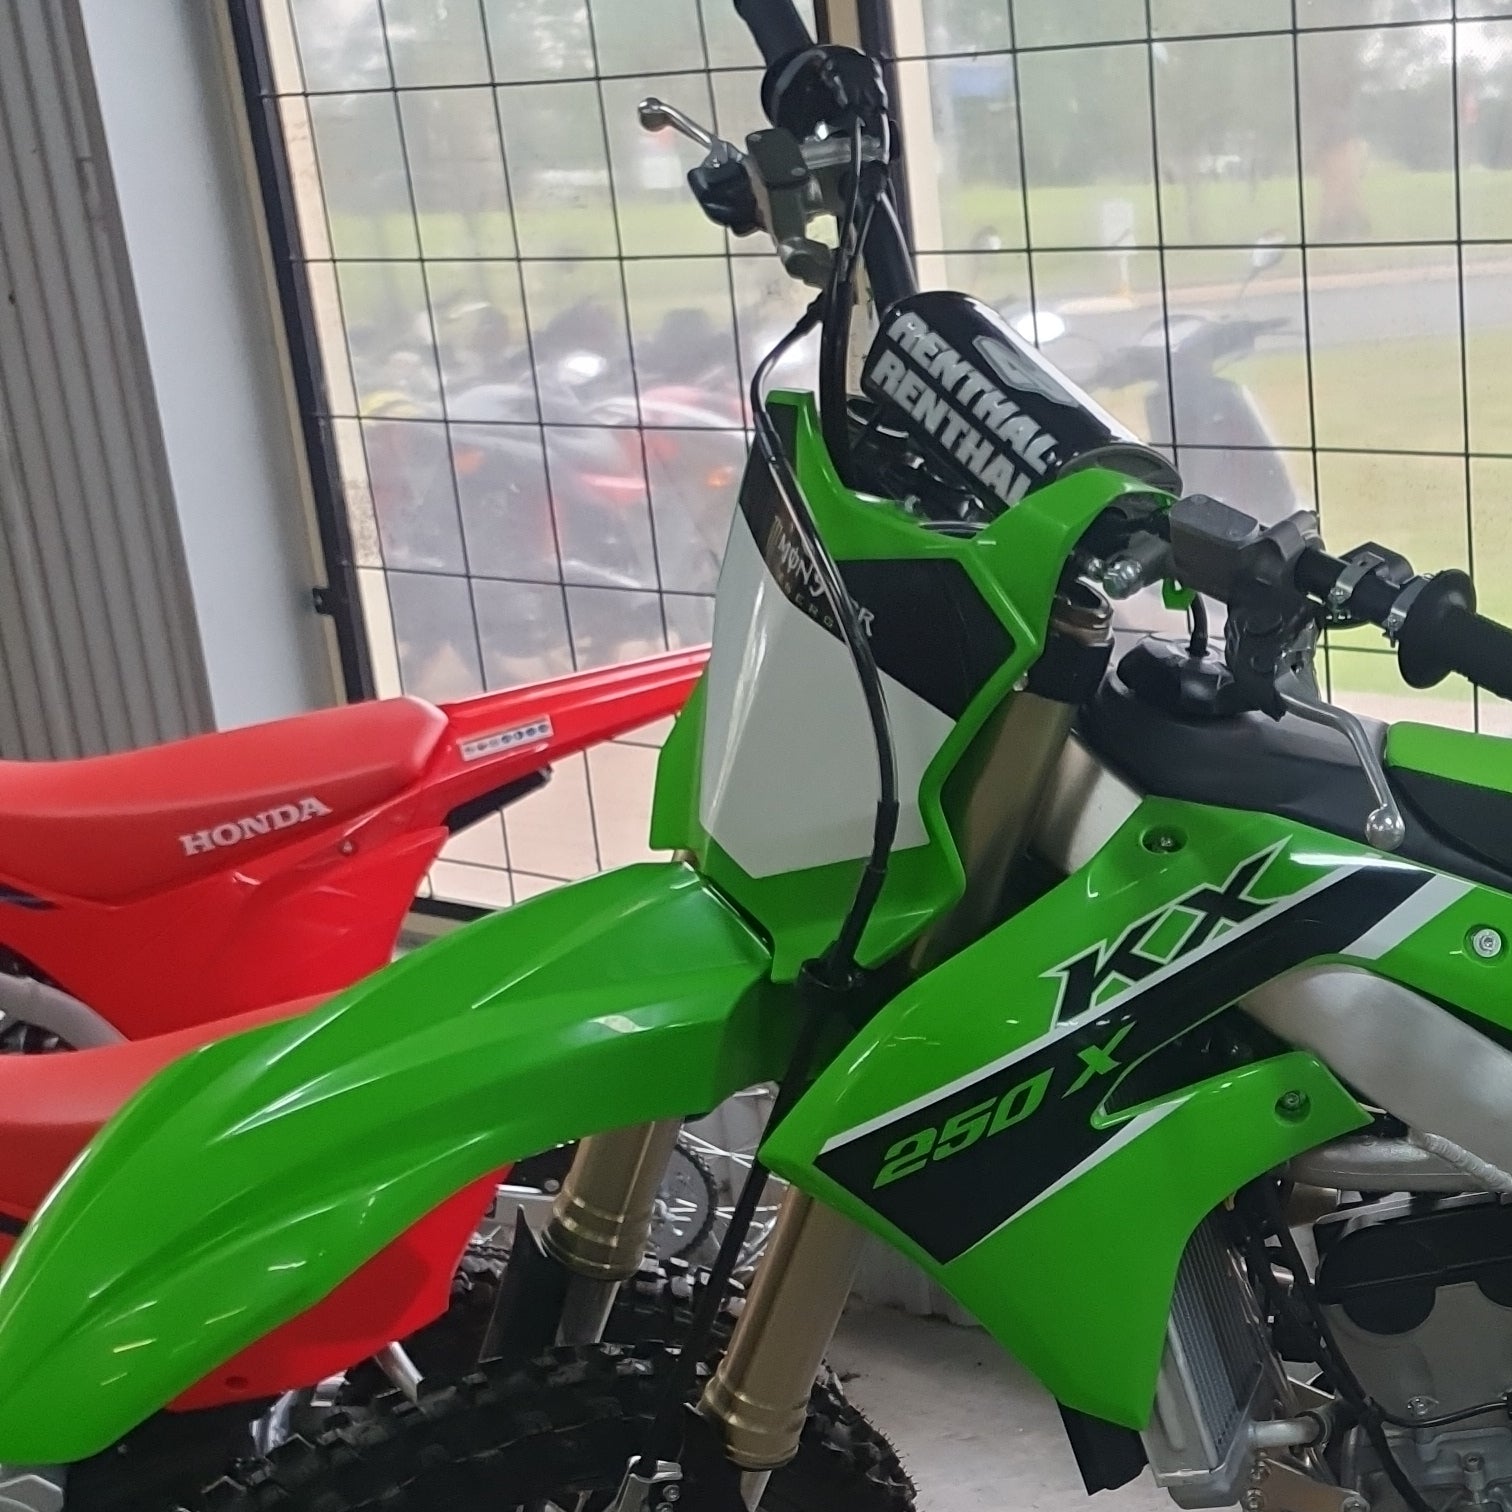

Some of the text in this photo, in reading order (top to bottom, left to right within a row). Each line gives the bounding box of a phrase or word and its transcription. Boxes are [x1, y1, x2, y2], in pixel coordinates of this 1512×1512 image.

[886, 311, 1059, 475] RENTHAL
[180, 796, 333, 856] HONDA
[1038, 835, 1294, 1032] KX
